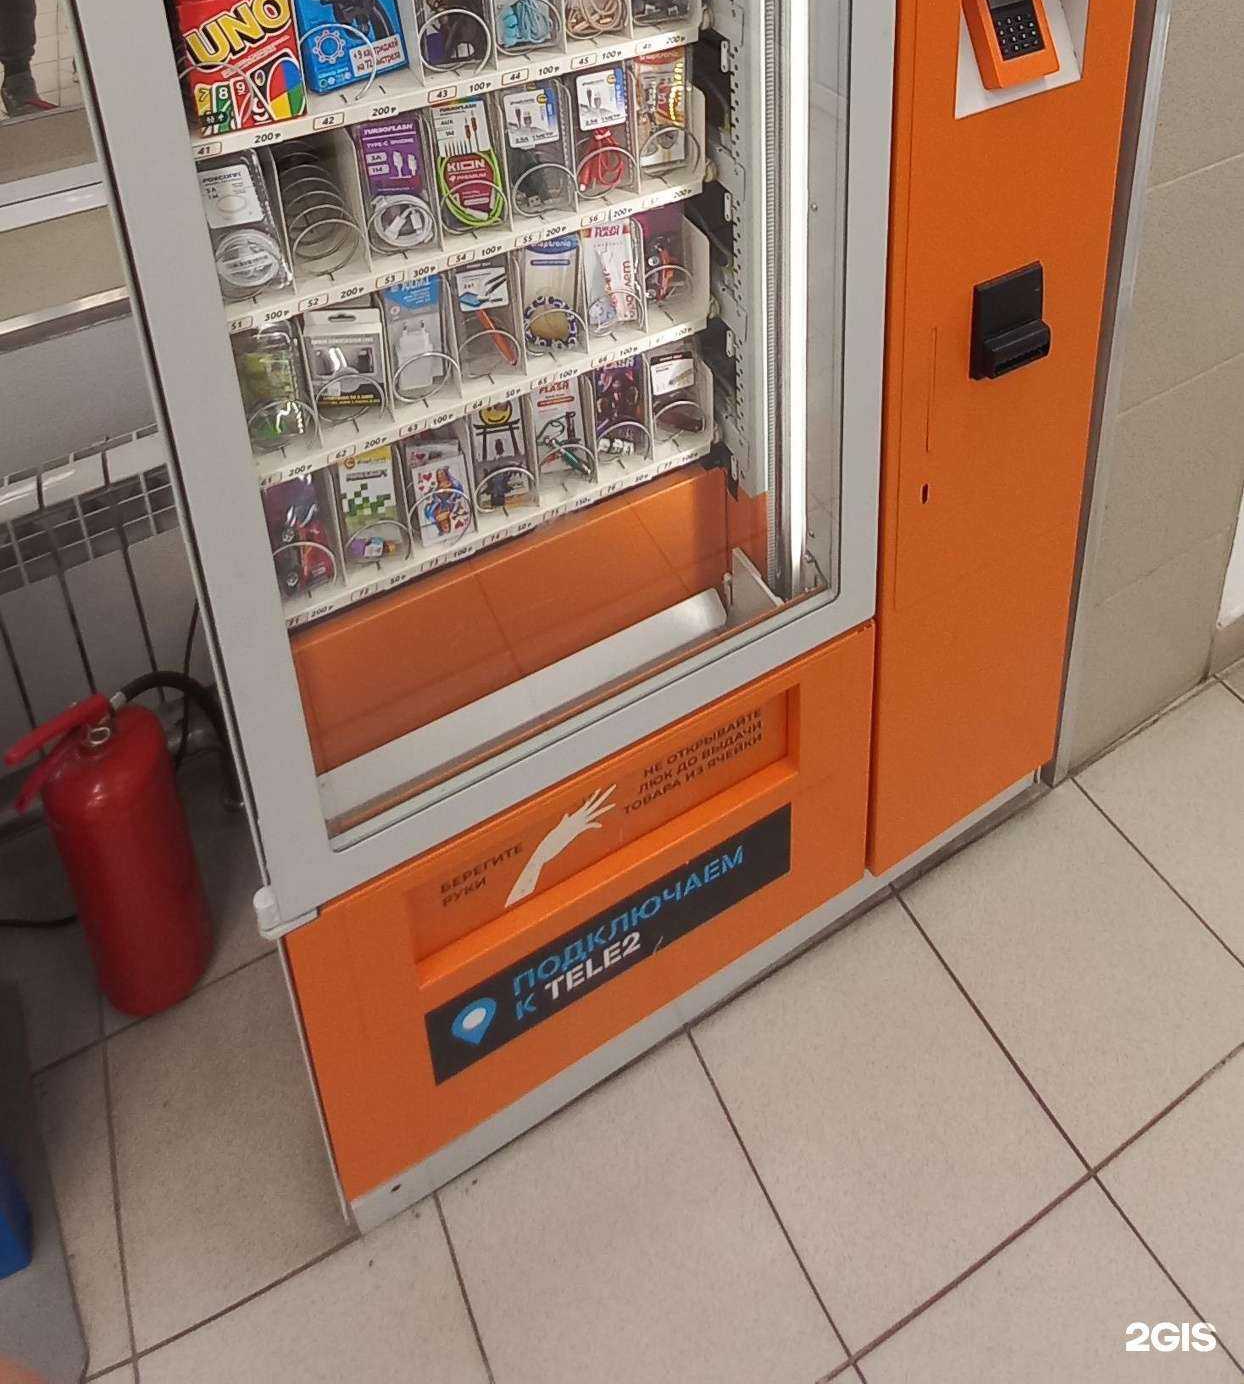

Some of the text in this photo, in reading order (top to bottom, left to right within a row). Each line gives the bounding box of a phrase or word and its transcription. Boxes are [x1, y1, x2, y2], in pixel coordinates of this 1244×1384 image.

[578, 57, 589, 65] 45
[510, 72, 521, 81] 44
[218, 86, 229, 100] 8
[436, 89, 448, 99] 43
[322, 116, 335, 125] 42
[197, 146, 210, 154] 41
[639, 720, 762, 794] ЛЮК ДО ВЫДАЧИ
[643, 708, 761, 778] НЕ ОТКРЫВАЙТЕ
[624, 733, 763, 815] ТОВАРА ИЗ ЯЧЕЙКИ
[439, 842, 524, 895] БЕРЕГИТЕ
[442, 877, 487, 907] РУКИ
[512, 844, 744, 996] ПОДКЛЮЧАЕМ
[516, 931, 641, 1021] К TELE2
